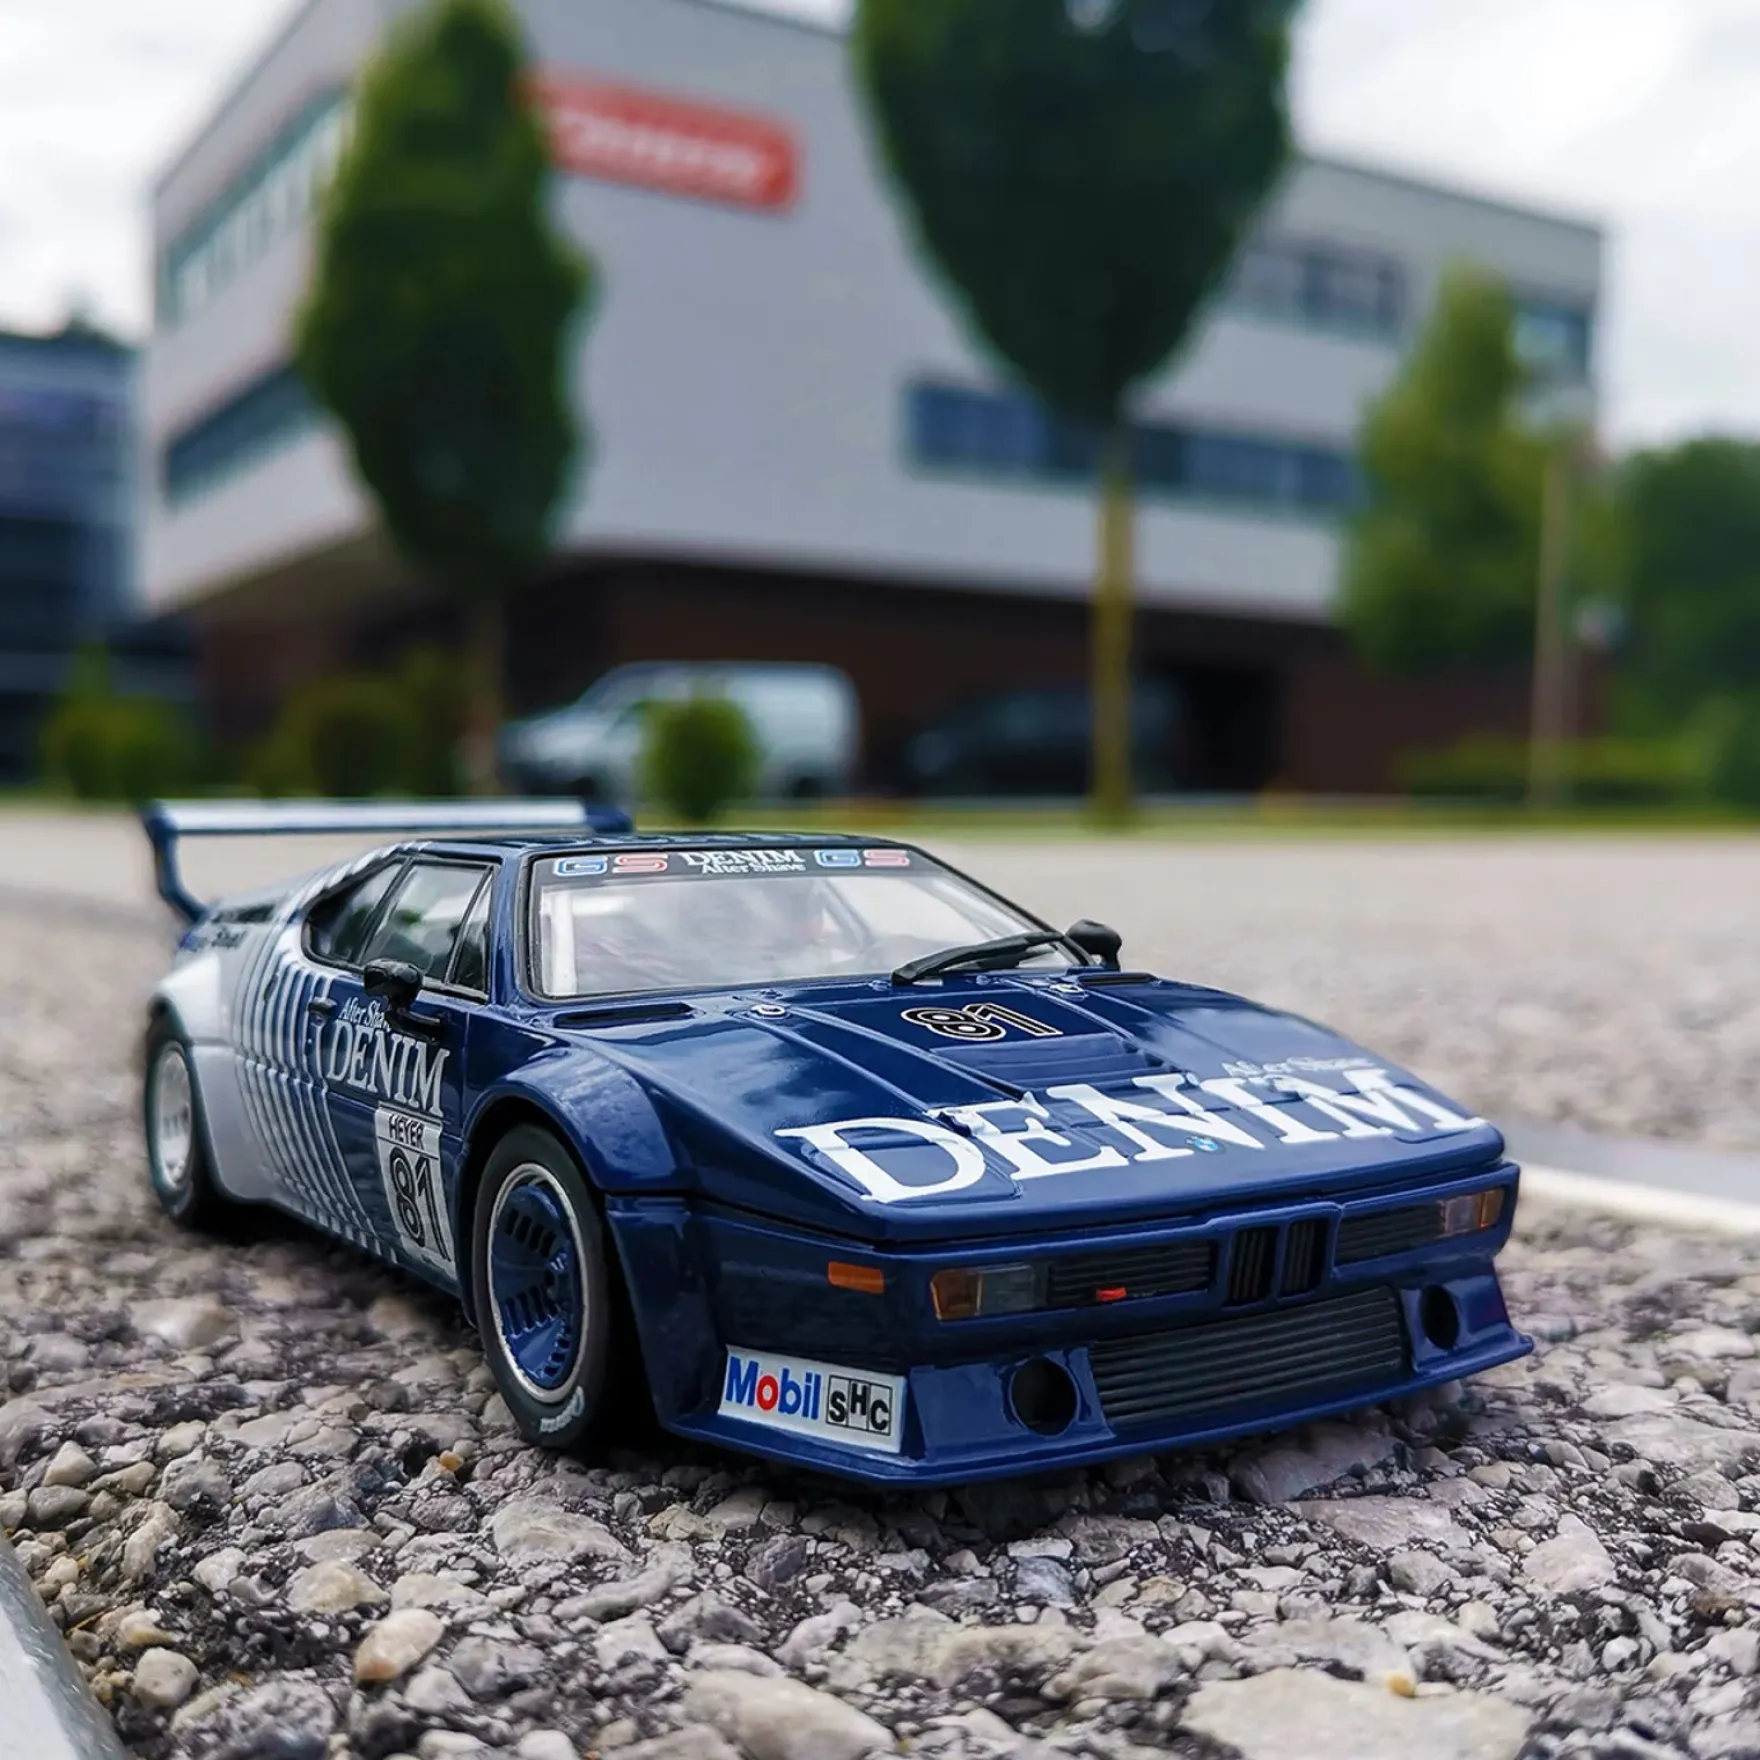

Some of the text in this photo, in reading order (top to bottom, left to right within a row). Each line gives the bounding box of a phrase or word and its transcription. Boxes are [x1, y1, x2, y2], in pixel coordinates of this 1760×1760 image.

[678, 850, 806, 866] DENIM
[900, 1002, 1064, 1042] 81
[327, 1019, 450, 1117] DENIM
[389, 1114, 424, 1150] HEYER
[773, 1068, 1488, 1202] DENIM
[390, 1147, 452, 1262] 81
[725, 1356, 890, 1431] Mobil SHC
